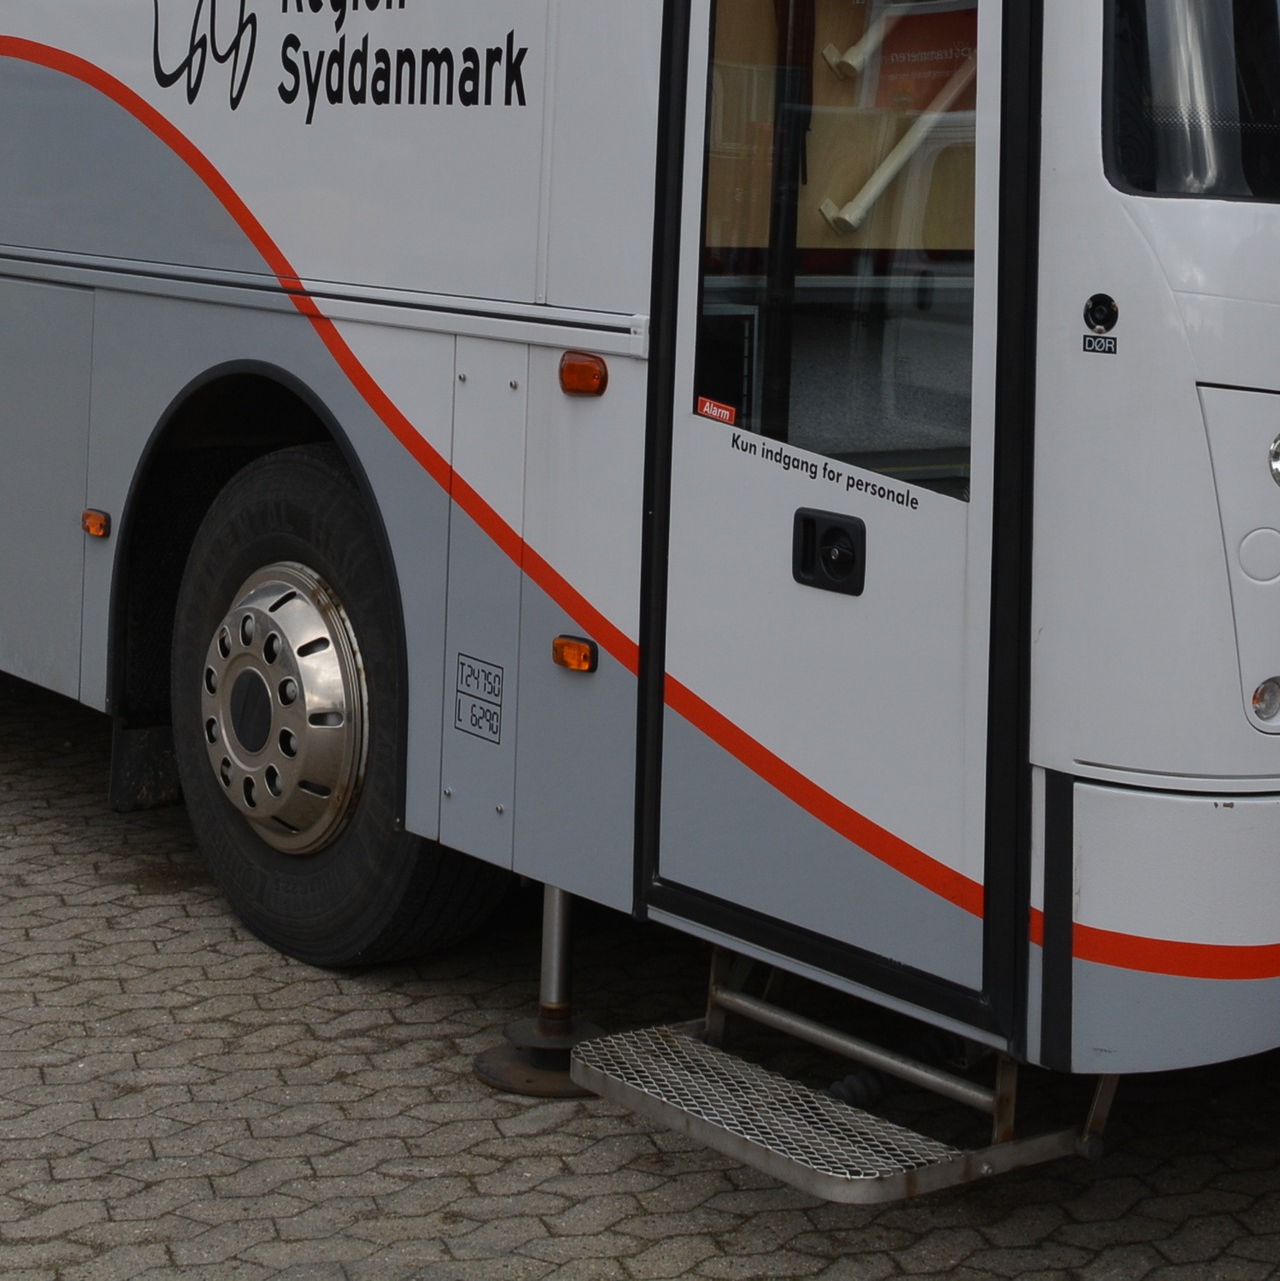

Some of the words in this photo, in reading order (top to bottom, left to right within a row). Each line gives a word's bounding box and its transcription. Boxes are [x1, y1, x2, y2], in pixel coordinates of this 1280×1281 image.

[277, 29, 529, 125] Syddanmark
[1085, 337, 1115, 352] DØR
[703, 401, 730, 420] Alarm
[731, 432, 757, 456] Kun
[761, 442, 818, 479] indgang
[822, 462, 842, 484] for
[846, 474, 919, 510] personale
[470, 704, 498, 735] 6290
